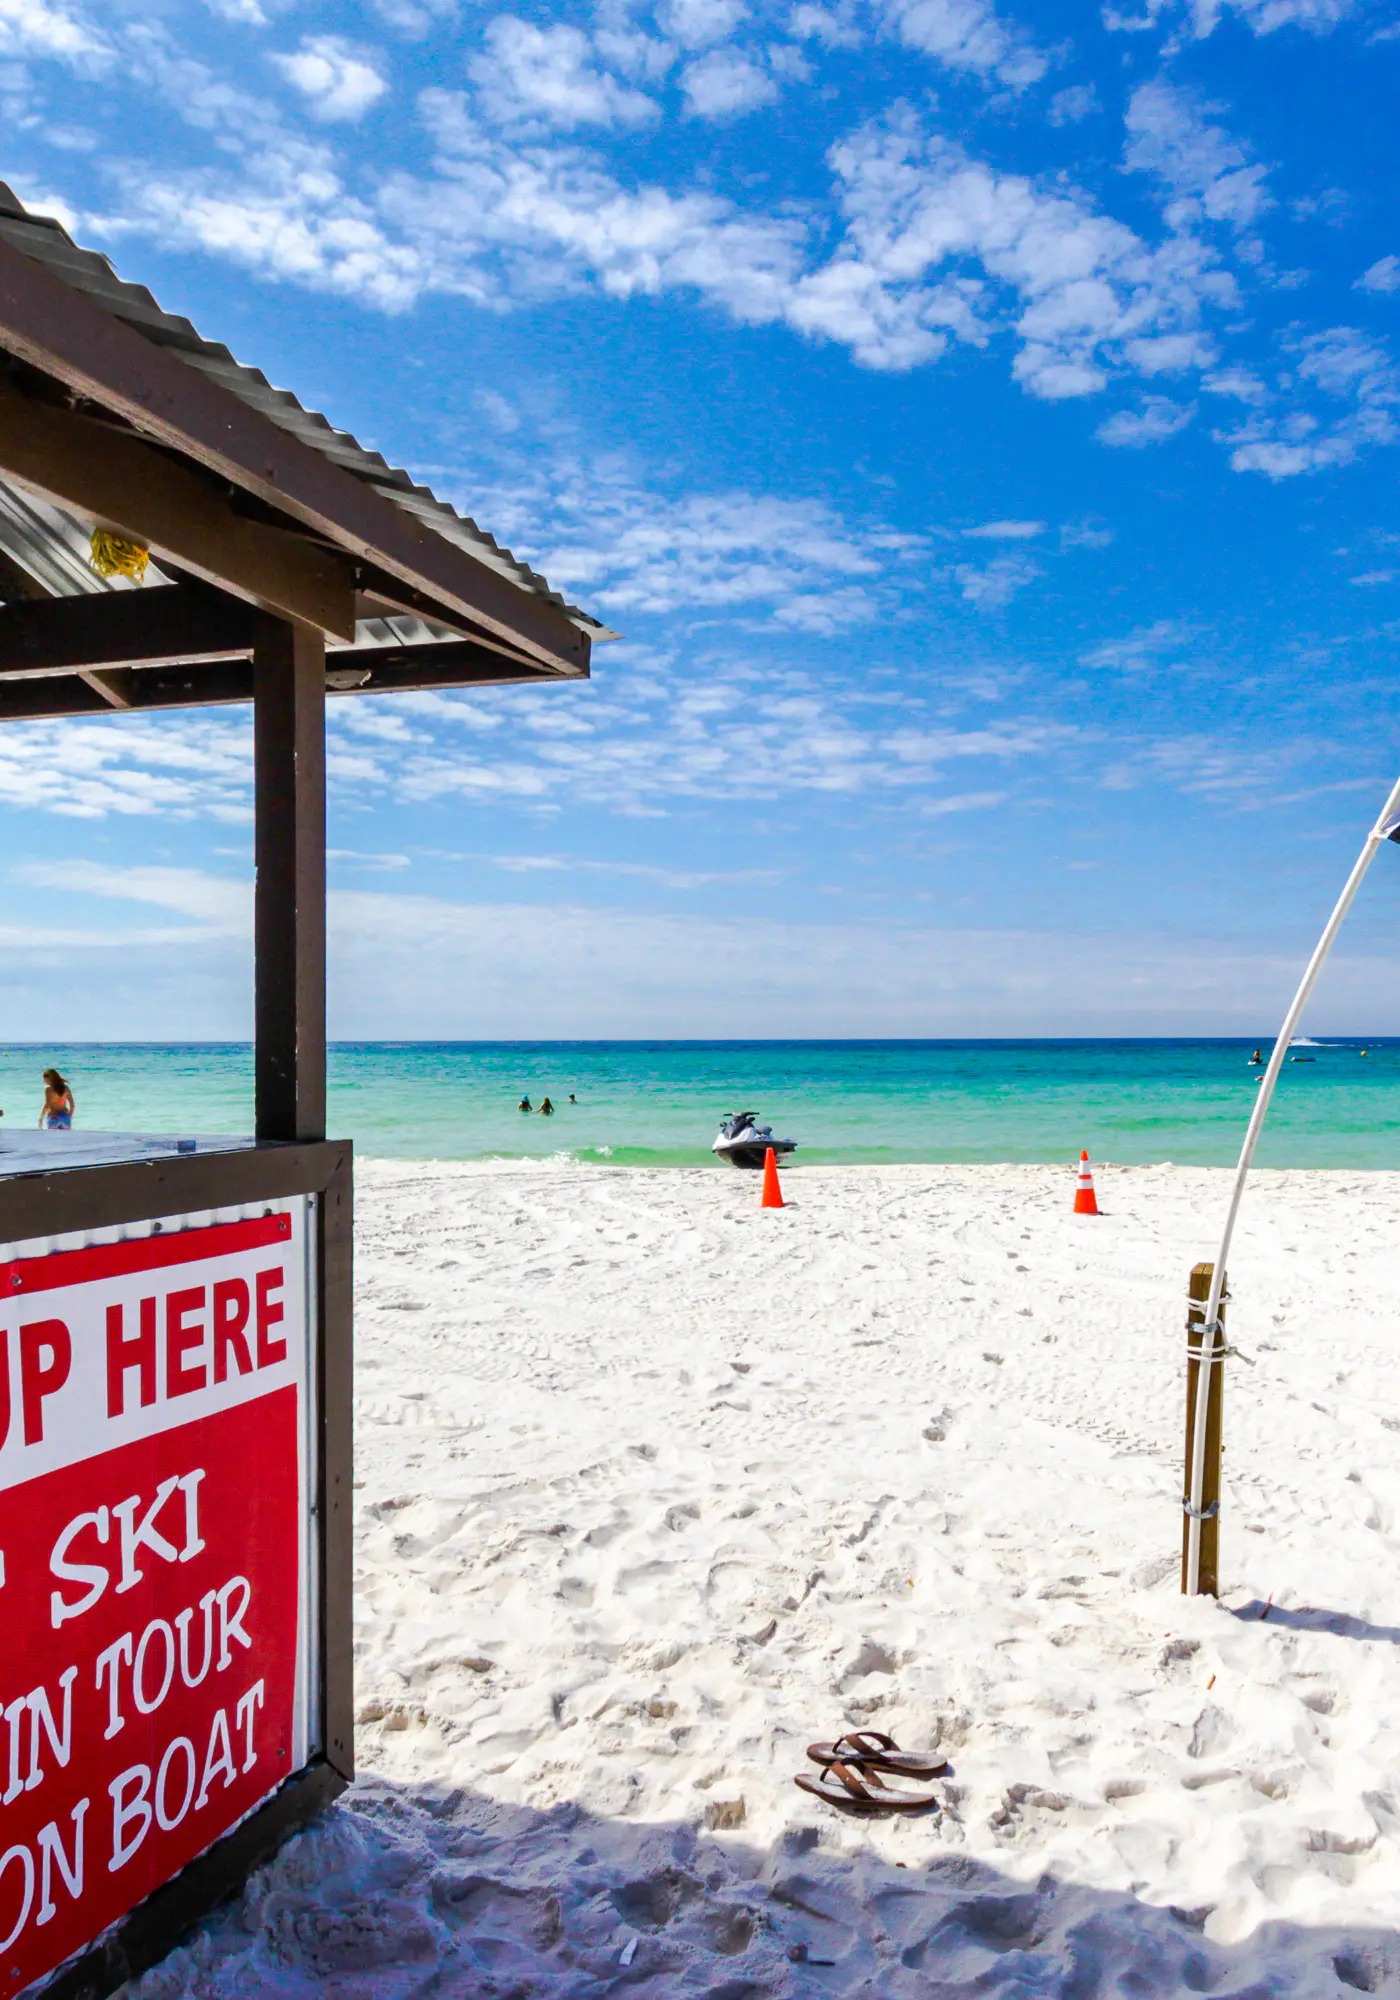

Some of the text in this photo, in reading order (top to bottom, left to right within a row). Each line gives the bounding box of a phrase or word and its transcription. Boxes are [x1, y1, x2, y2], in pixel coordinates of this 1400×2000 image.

[0, 1266, 287, 1450] P HERE
[49, 1467, 207, 1629] SKI
[0, 1575, 253, 1806] IN TOUR
[107, 1678, 265, 1873] BOAT
